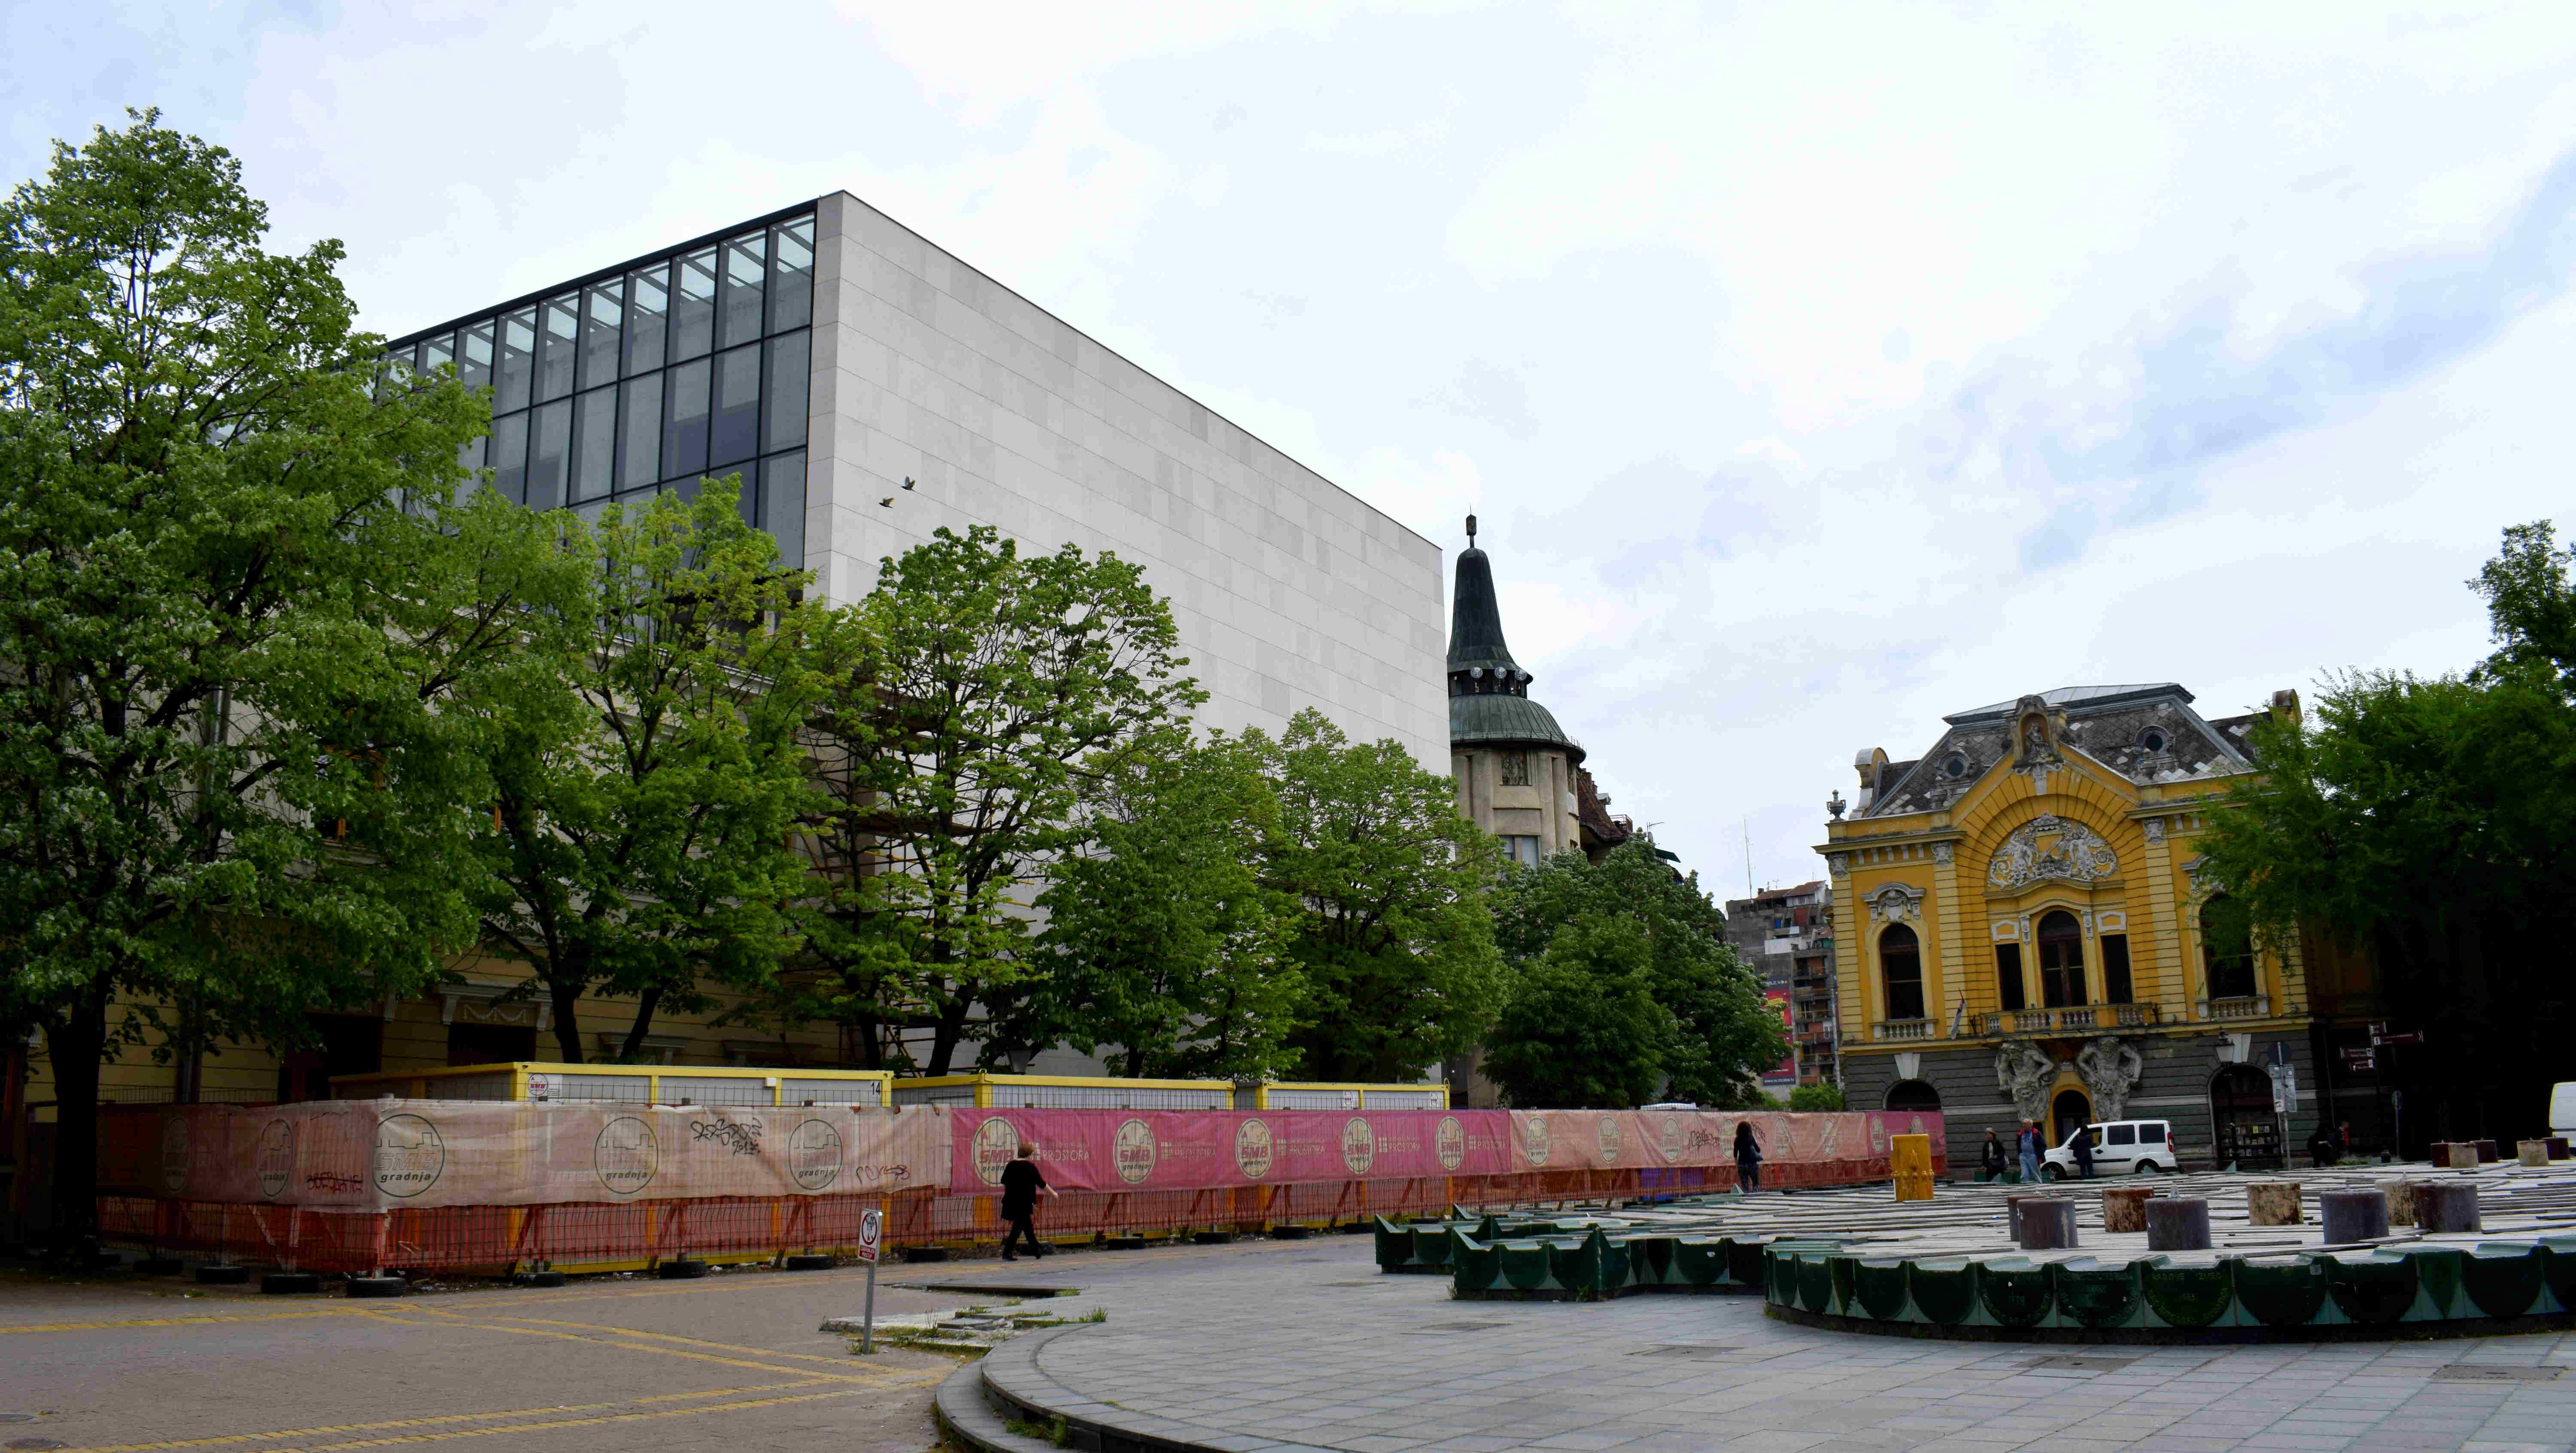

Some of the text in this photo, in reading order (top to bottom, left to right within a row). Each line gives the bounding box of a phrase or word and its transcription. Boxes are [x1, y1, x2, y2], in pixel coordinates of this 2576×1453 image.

[871, 1082, 880, 1096] 14
[1241, 1146, 1268, 1158] SMB
[1347, 1143, 1370, 1155] SMB
[374, 1151, 436, 1170] SMB
[979, 1149, 1015, 1163] SMB
[1043, 1150, 1090, 1161] PROSTORA
[1119, 1149, 1151, 1162] SMB
[982, 1162, 1005, 1173] gradn
[1123, 1163, 1148, 1171] gradnja
[380, 1172, 431, 1182] gradnja
[606, 1171, 648, 1181] gradnja
[799, 1168, 835, 1178] gradnja
